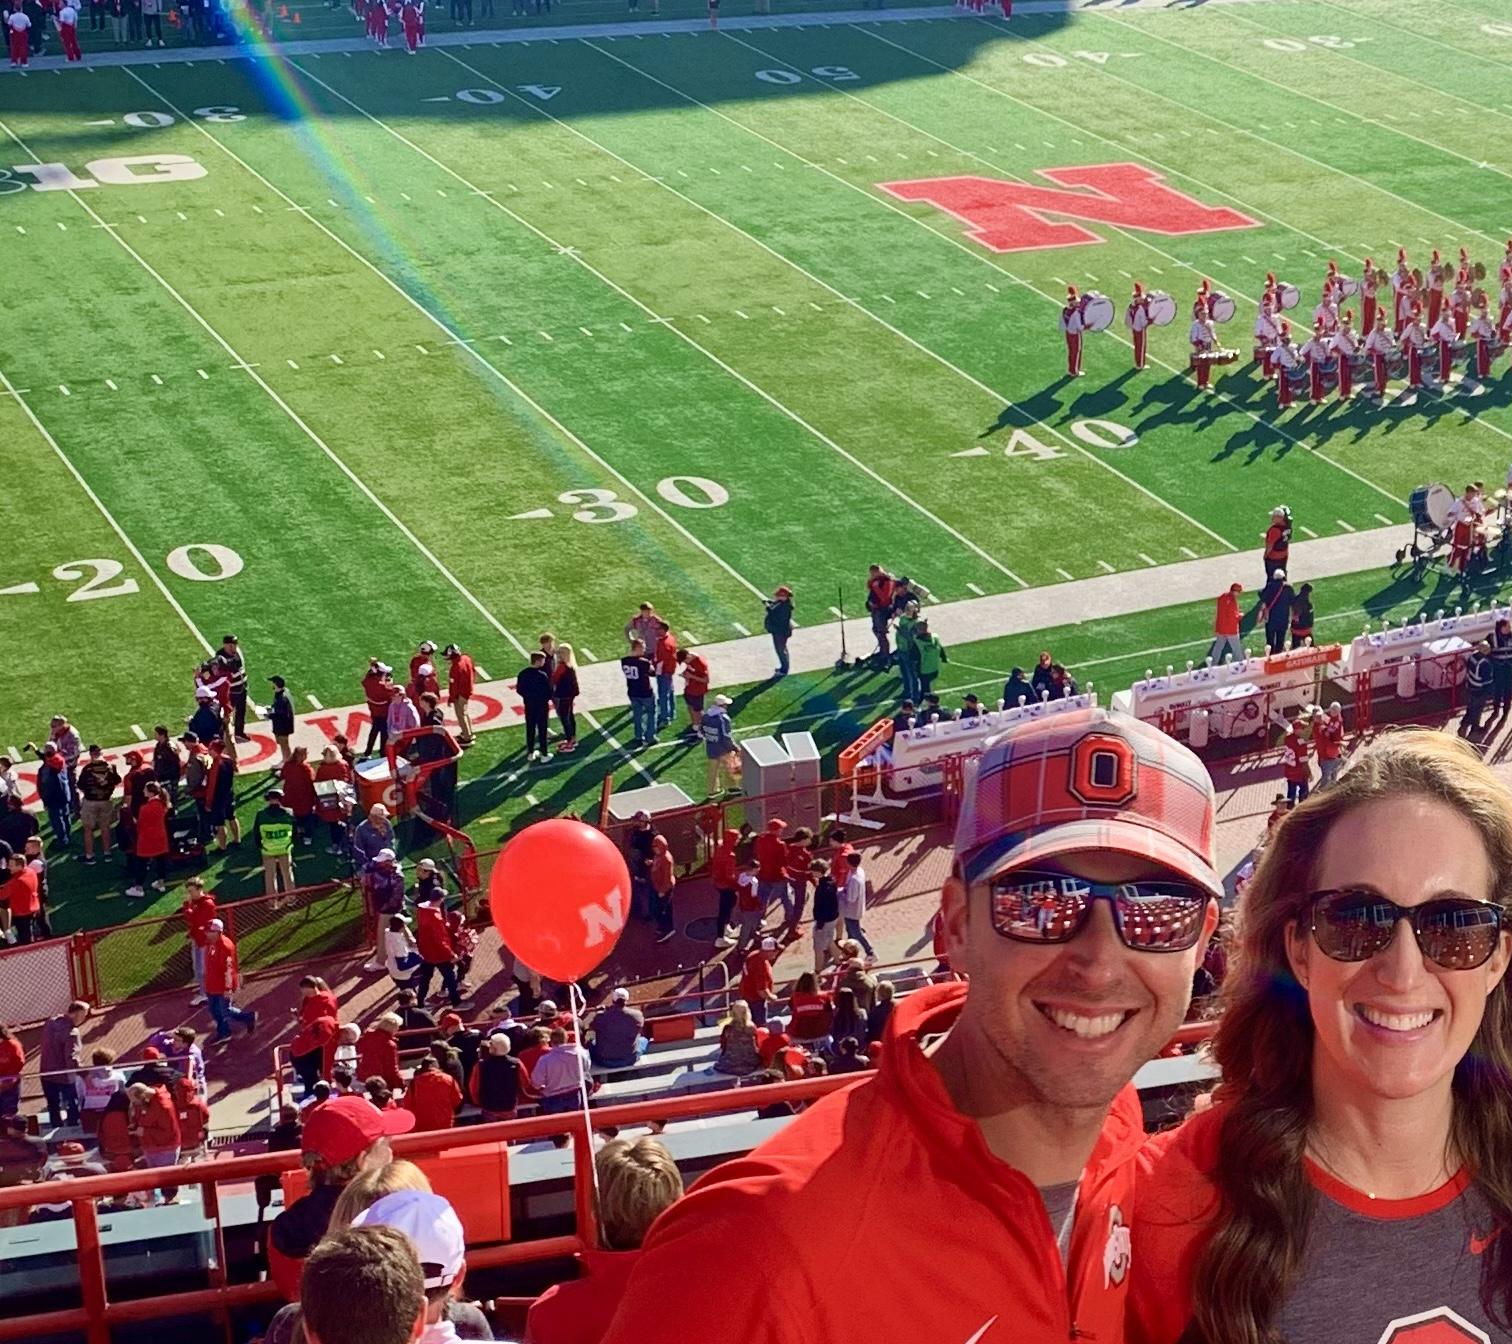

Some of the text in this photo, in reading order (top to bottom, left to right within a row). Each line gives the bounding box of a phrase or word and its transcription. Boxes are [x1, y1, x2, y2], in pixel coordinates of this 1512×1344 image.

[1263, 33, 1356, 53] 30
[454, 82, 563, 105] 40
[754, 64, 863, 86] 50
[122, 105, 248, 129] 30
[874, 161, 1265, 254] N
[1004, 418, 1140, 462] 40
[557, 474, 731, 526] 30
[52, 541, 245, 603] 20
[579, 888, 625, 950] N
